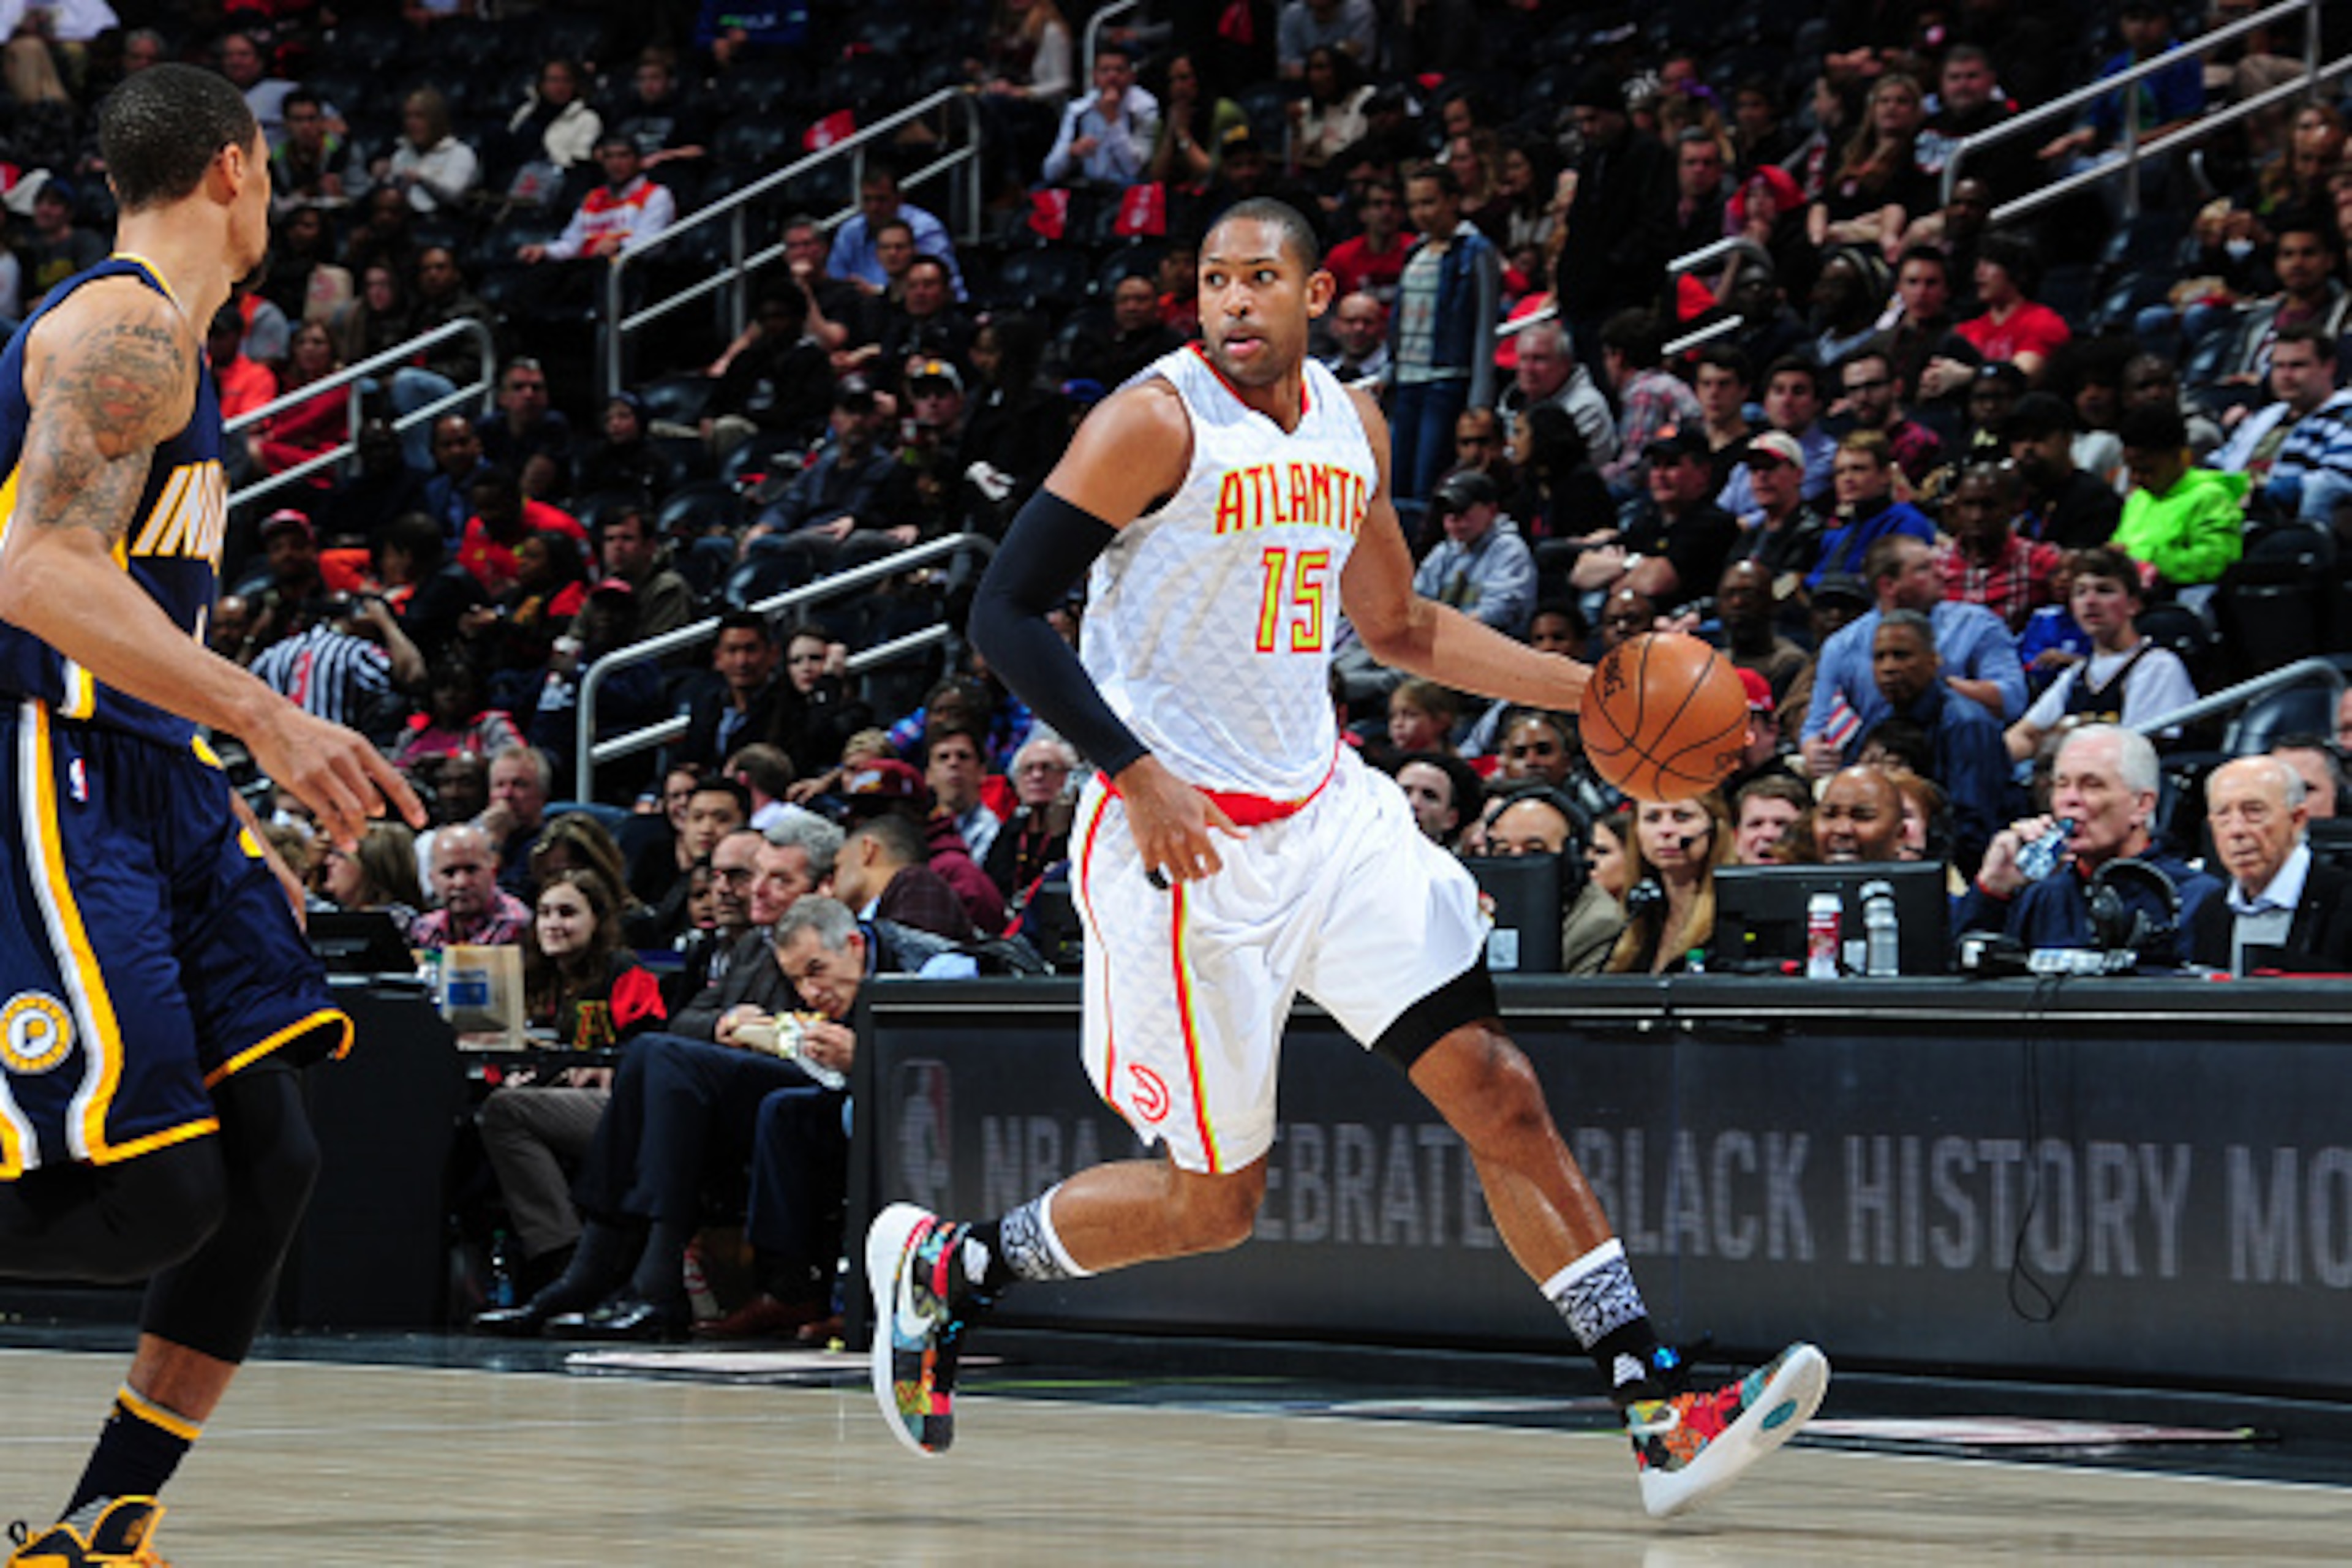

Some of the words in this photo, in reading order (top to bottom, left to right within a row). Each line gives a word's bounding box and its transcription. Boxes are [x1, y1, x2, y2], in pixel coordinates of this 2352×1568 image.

[1256, 547, 1331, 653] 15
[1575, 1126, 1815, 1261] BLACK
[1844, 1134, 2192, 1278] HISTORY
[2226, 1143, 2352, 1289] MO
